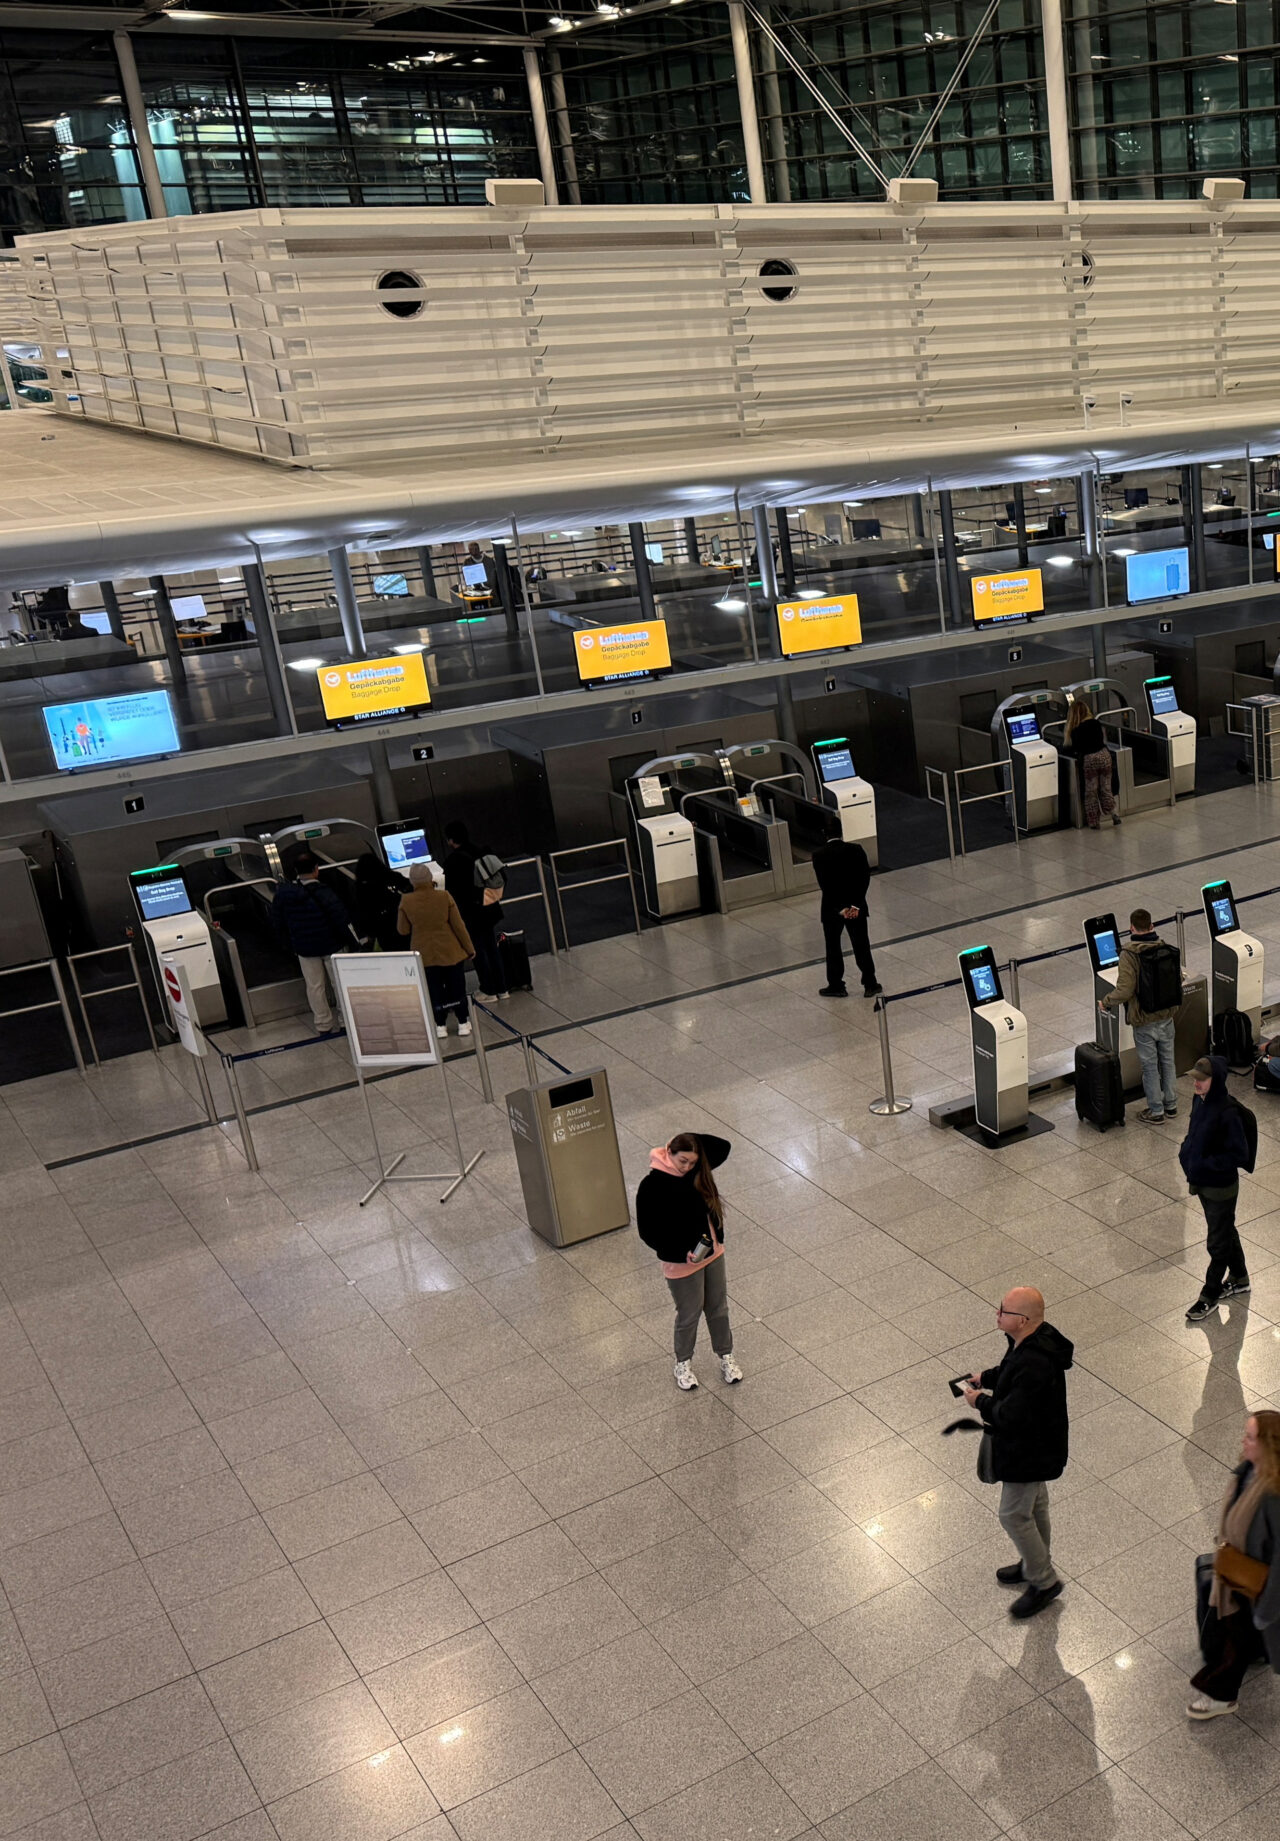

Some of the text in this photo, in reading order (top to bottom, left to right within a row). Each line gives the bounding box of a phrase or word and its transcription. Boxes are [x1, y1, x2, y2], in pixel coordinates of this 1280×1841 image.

[990, 578, 1029, 590] Lufthansa
[798, 604, 844, 618] Lufthansa
[1163, 623, 1168, 631] 6
[598, 631, 649, 646] Lufthansa
[601, 641, 650, 653] Gepäckabgabe
[346, 665, 405, 682] Lufthansa
[349, 676, 405, 690] Gepäckabgabe
[351, 685, 401, 699] Baggage Drop
[354, 707, 400, 720] STAR ALLIANCE
[420, 749, 428, 759] 2
[131, 800, 137, 811] 1
[404, 965, 416, 977] M
[566, 1105, 587, 1117] Abfall
[568, 1120, 591, 1132] Waste
